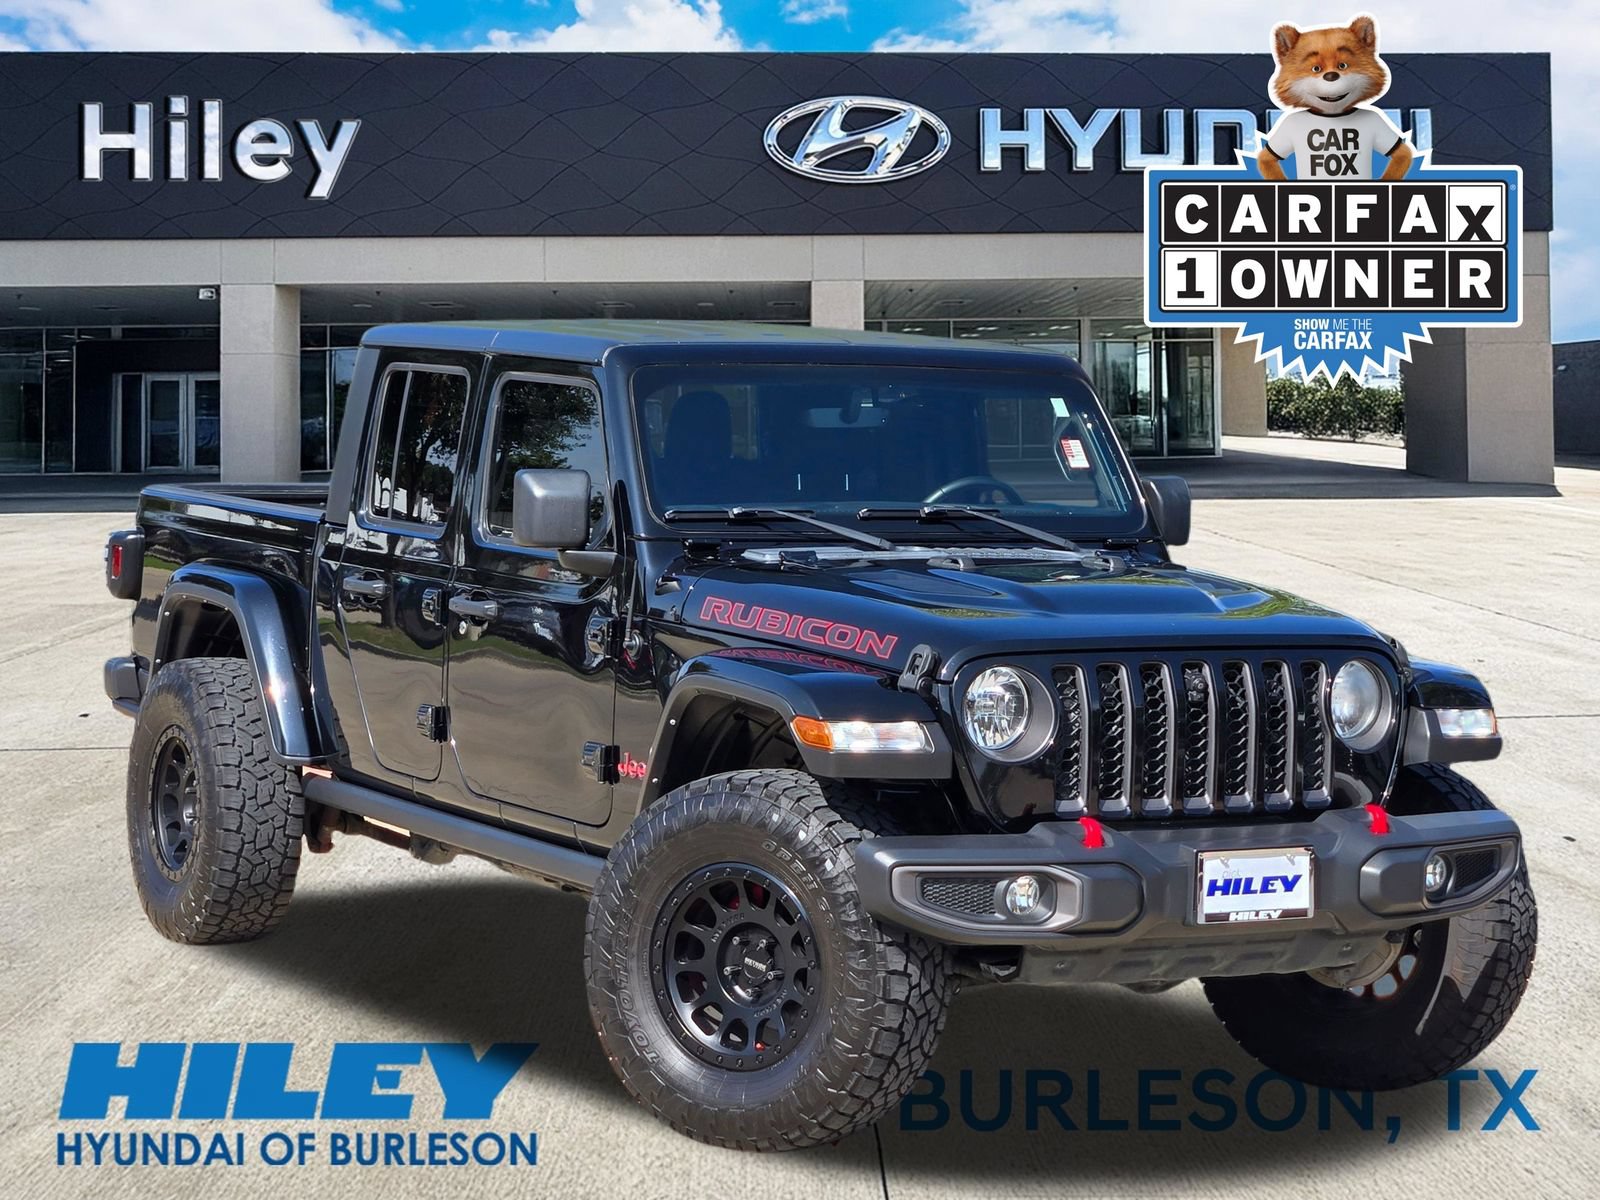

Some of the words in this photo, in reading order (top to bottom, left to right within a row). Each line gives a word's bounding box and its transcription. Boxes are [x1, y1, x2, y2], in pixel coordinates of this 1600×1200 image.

[81, 95, 361, 199] Hiley
[979, 107, 1432, 172] HYUNI
[700, 596, 898, 659] RUBICON
[617, 752, 647, 779] Jee
[1206, 874, 1303, 897] HILEY
[1228, 909, 1283, 921] HILEY
